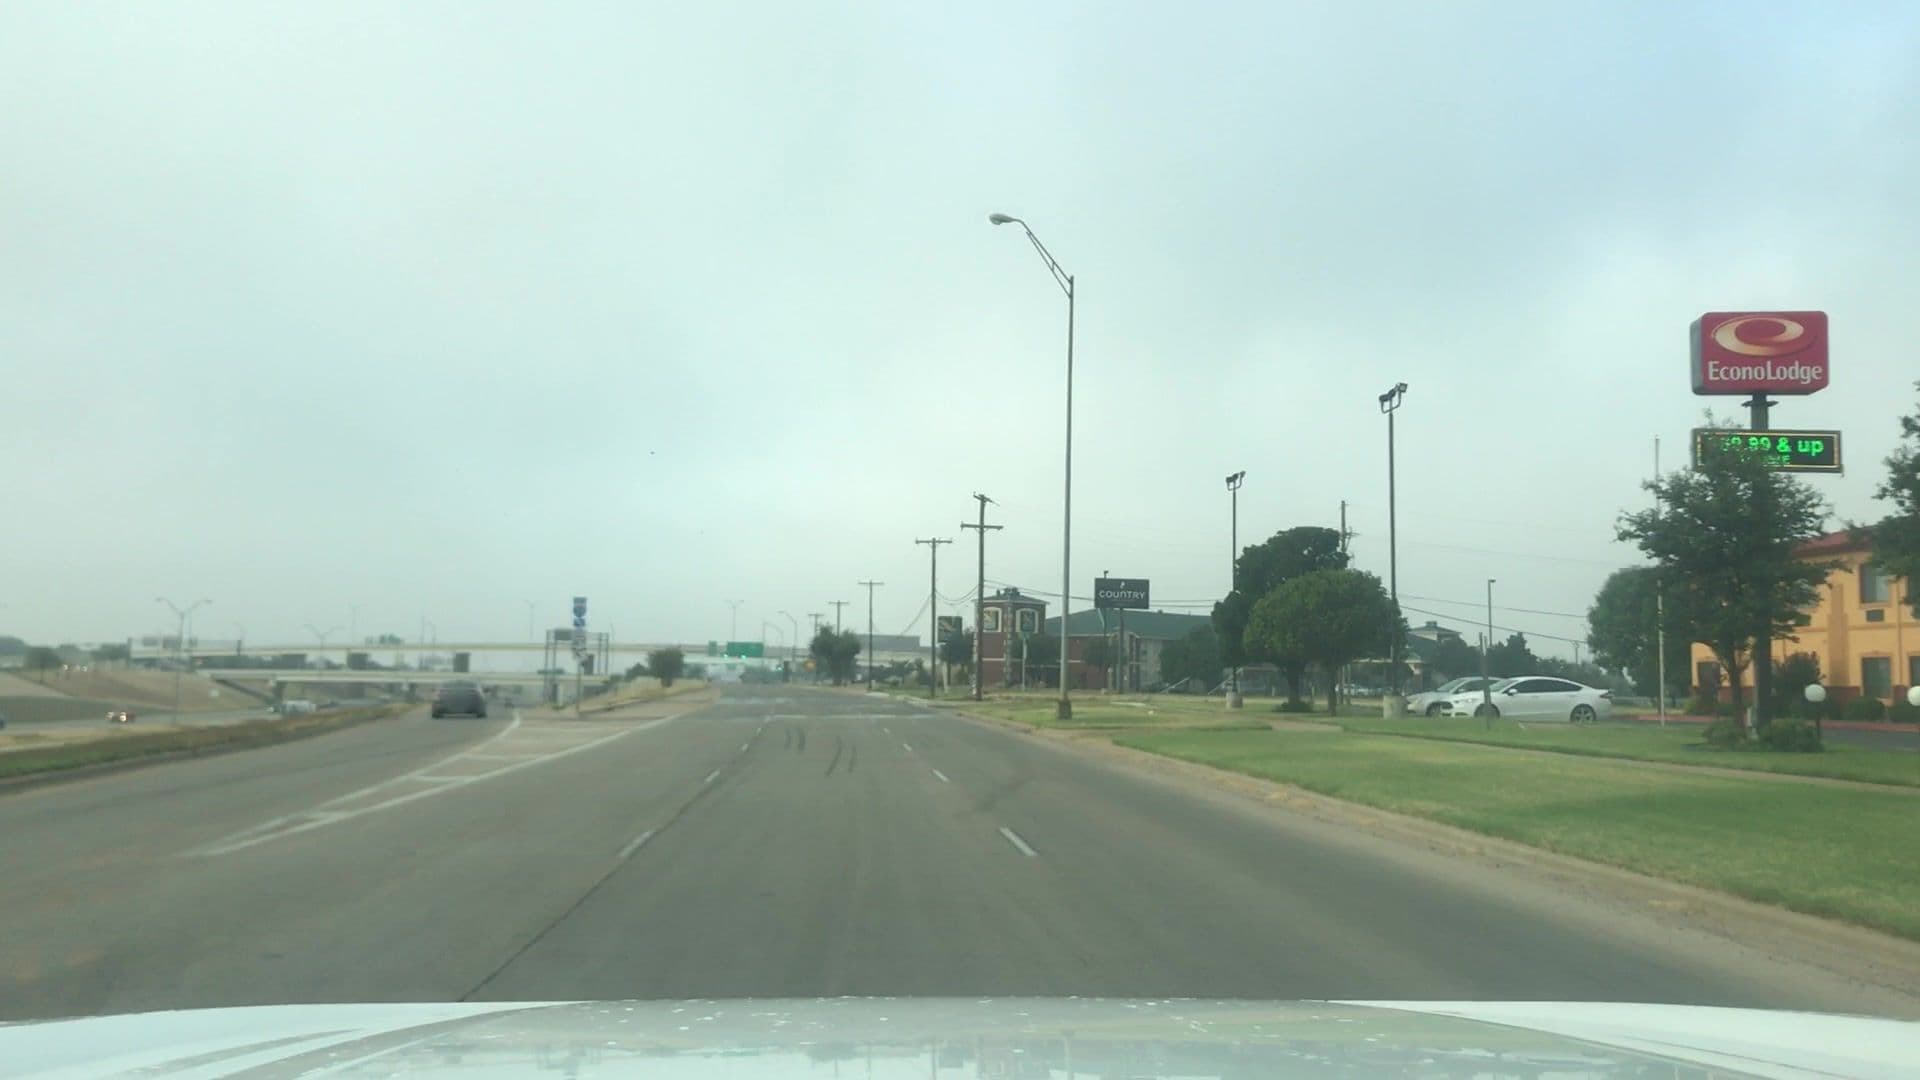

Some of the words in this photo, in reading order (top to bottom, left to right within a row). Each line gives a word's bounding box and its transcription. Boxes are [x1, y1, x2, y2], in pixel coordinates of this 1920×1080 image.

[1707, 360, 1823, 385] EconoLodge
[1776, 436, 1791, 452] &
[1798, 440, 1824, 456] up
[1098, 590, 1146, 599] COUNTRY
